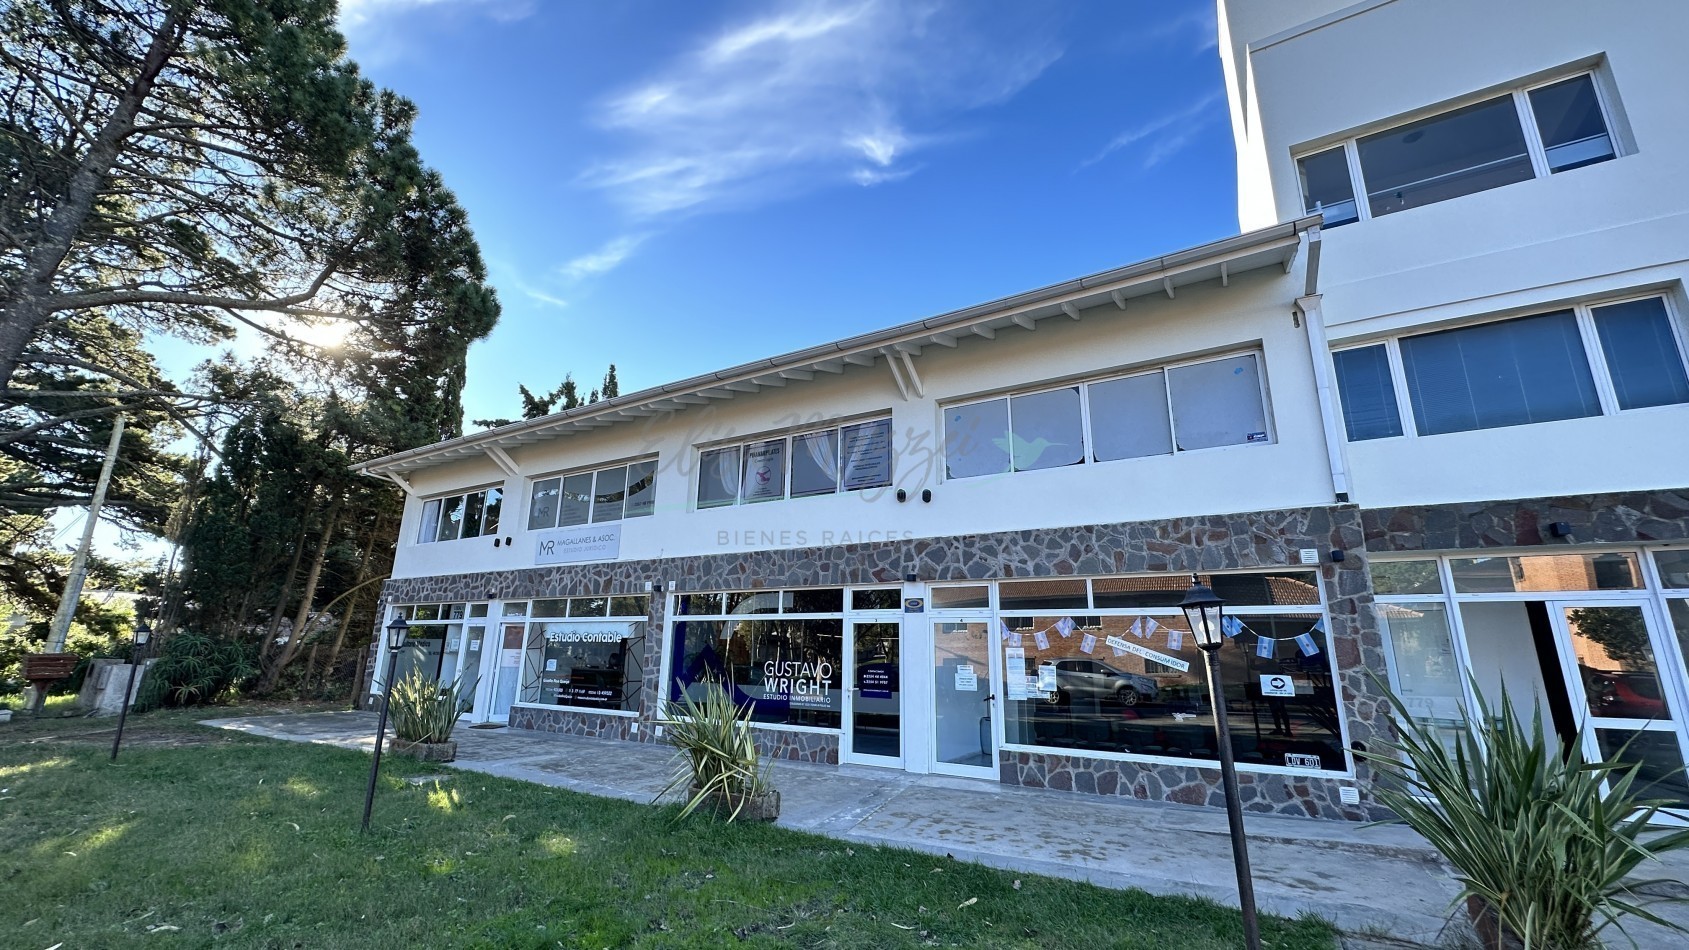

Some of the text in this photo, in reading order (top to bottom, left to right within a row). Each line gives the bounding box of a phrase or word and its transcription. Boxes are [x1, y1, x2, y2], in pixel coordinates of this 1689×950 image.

[539, 540, 555, 556] MR
[557, 536, 592, 546] MAGALLANES
[549, 629, 623, 643] Estudio Contable
[1107, 638, 1186, 669] DEFENSA DEL CONSUMIDOR
[763, 660, 832, 679] GUSTAVO
[764, 678, 832, 695] WRIGHT
[763, 693, 831, 703] ESTUDIO INMOBILIARIO
[1304, 758, 1319, 767] 601
